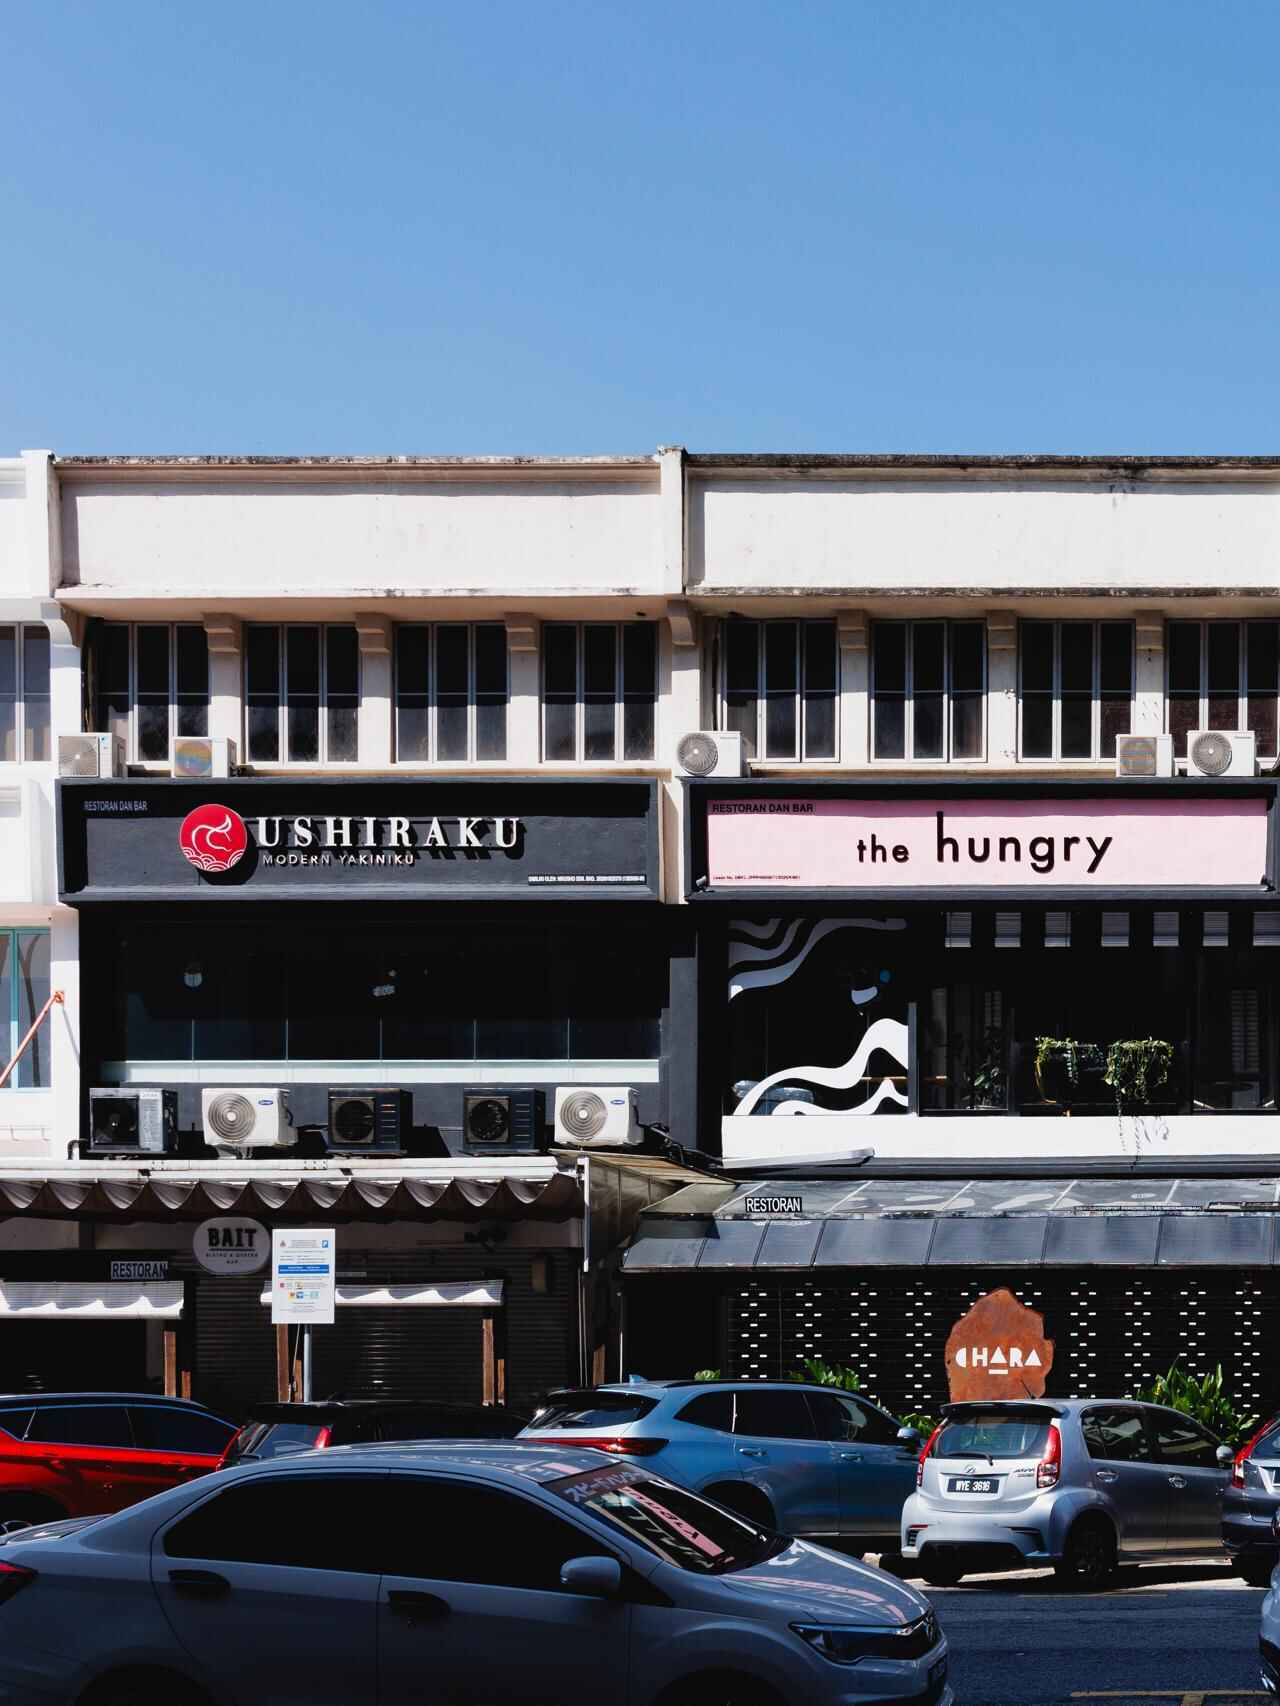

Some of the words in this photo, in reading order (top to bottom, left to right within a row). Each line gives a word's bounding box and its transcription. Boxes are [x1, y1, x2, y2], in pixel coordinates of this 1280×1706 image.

[83, 800, 118, 811] RESTORAN
[119, 800, 133, 811] DAN
[134, 800, 148, 811] BAR
[713, 803, 767, 813] RESTORAN
[769, 803, 789, 813] DAN
[792, 803, 813, 813] BAR
[256, 816, 519, 848] USHIRAKU
[857, 833, 909, 863] the
[936, 810, 1112, 874] hungry
[263, 854, 330, 865] MODERN
[339, 854, 414, 865] YAKINIKU
[747, 1198, 801, 1212] RESTORAN
[207, 1228, 257, 1247] BAIT
[112, 1263, 169, 1278] RESTORAN
[955, 1346, 1042, 1374] CHARA
